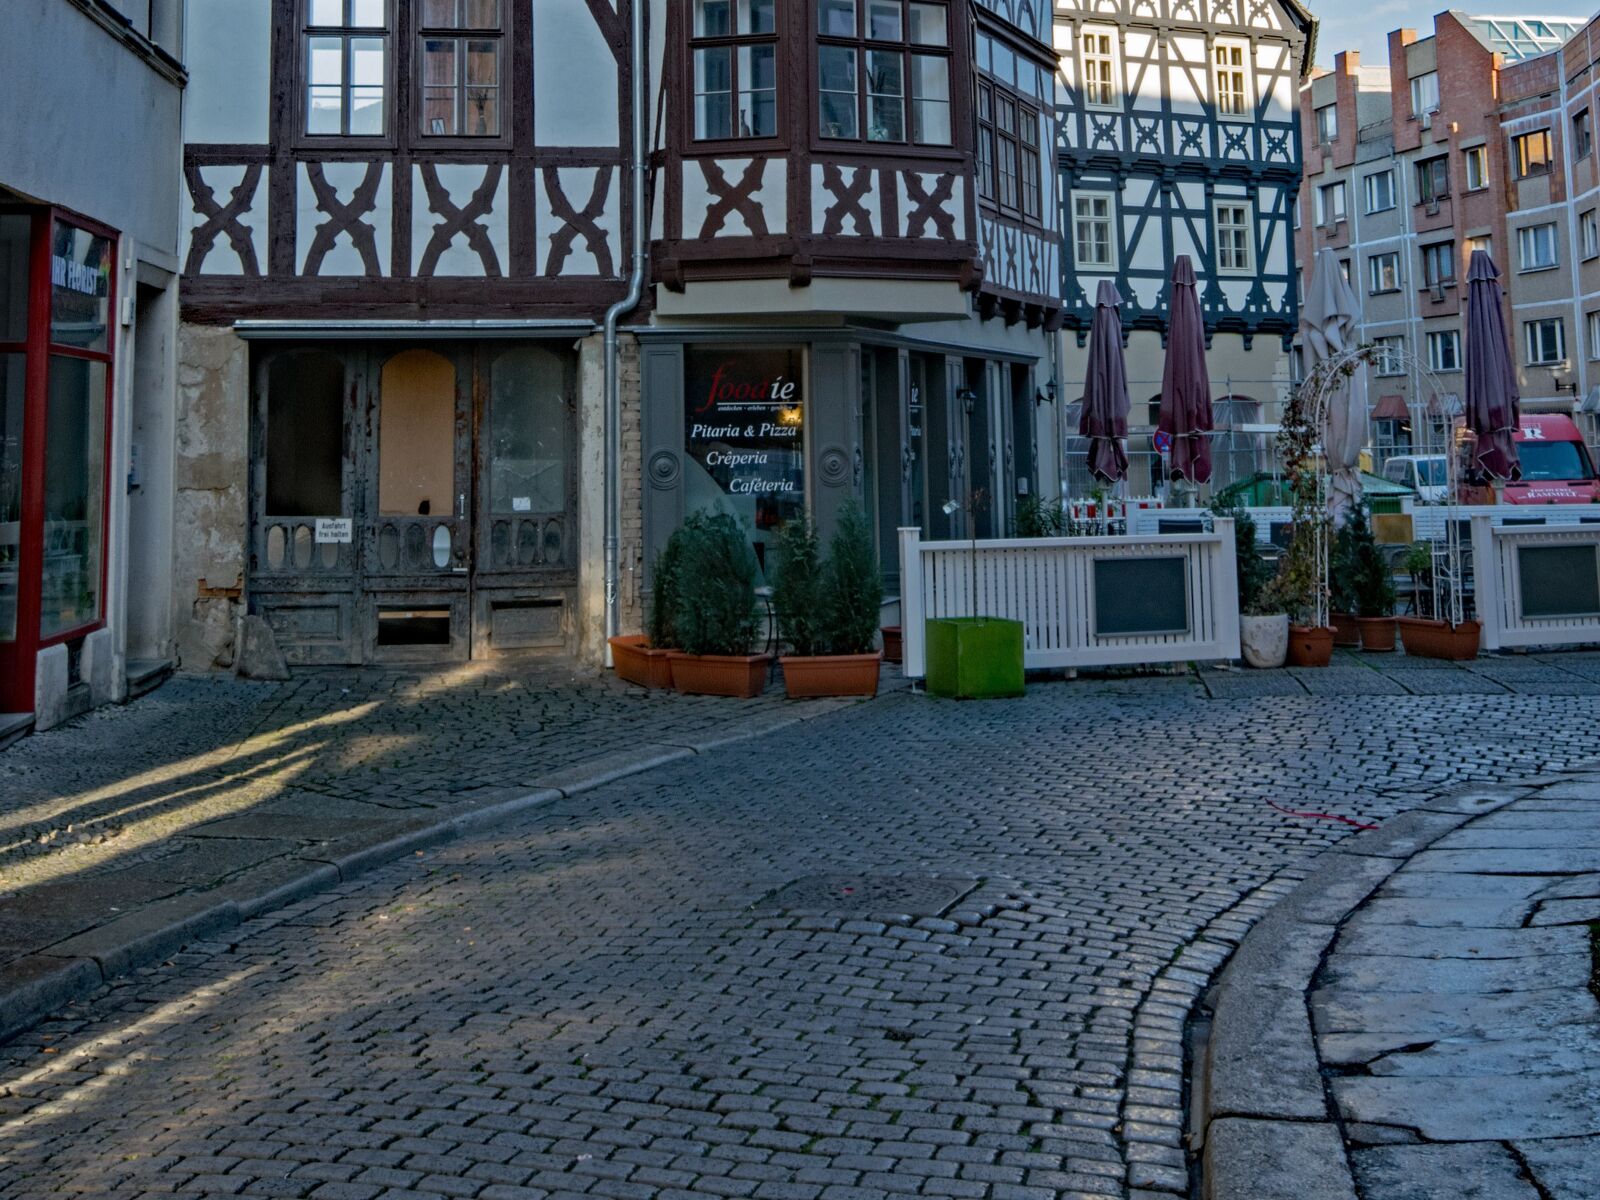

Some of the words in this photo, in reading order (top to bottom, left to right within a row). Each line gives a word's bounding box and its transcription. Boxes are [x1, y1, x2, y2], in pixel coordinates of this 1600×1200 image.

[52, 255, 67, 287] IHR
[68, 261, 97, 295] FLORIST
[691, 424, 740, 438] Pitaria
[744, 425, 755, 437] &
[759, 422, 797, 437] Pizza
[706, 451, 768, 468] Crêperia
